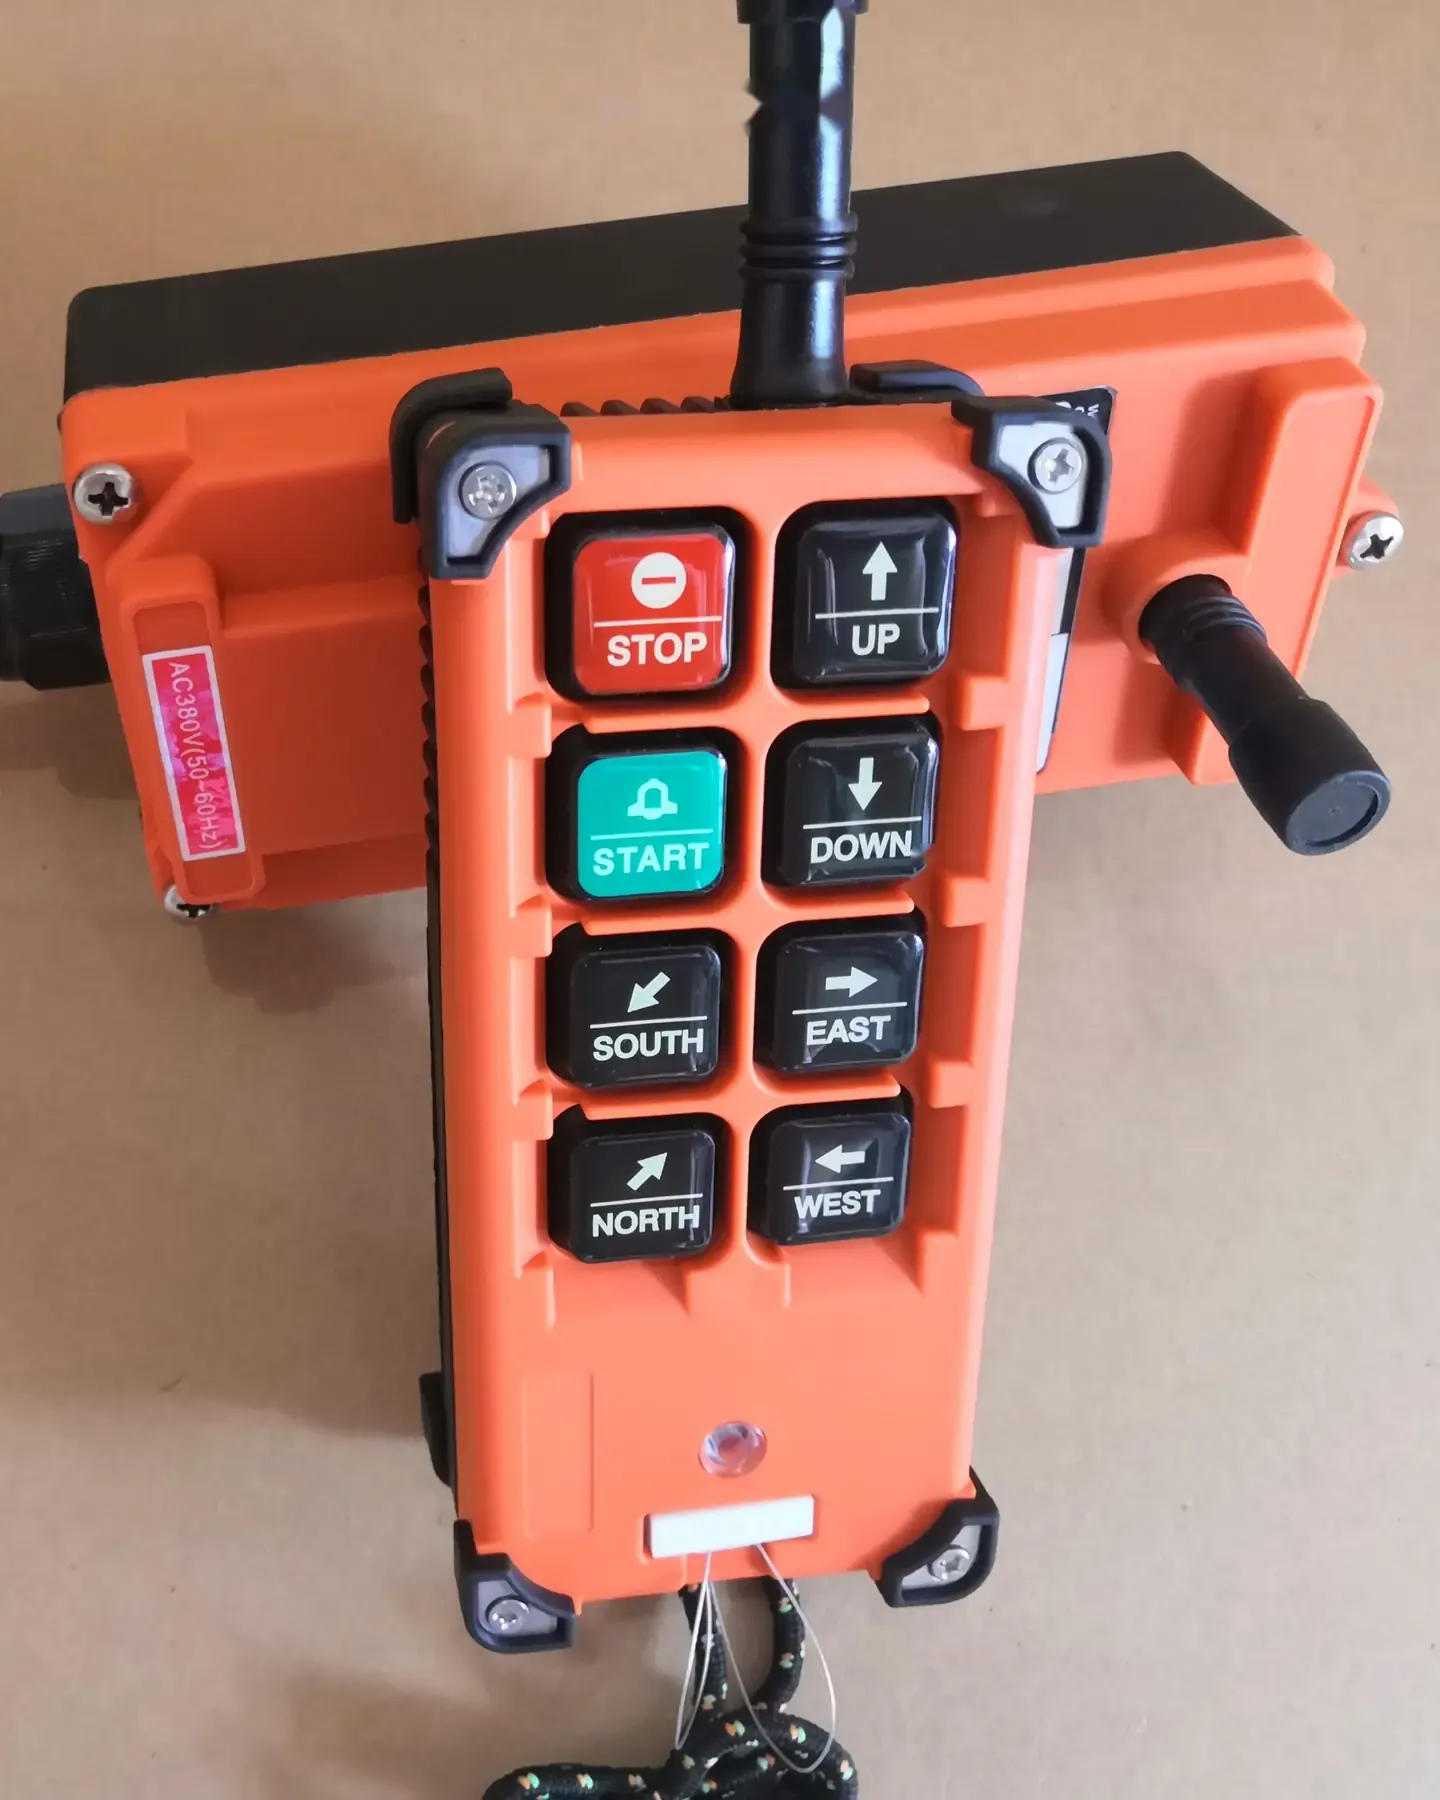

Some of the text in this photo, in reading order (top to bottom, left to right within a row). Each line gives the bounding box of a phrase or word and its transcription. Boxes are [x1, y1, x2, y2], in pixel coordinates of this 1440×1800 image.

[607, 632, 708, 667] STOP
[851, 623, 900, 656] UP
[592, 843, 710, 876] START
[810, 830, 913, 864] DOWN
[593, 1028, 704, 1062] SOUTH
[806, 1015, 891, 1046] EAST
[795, 1189, 881, 1219] WEST
[592, 1205, 700, 1238] NORTH
